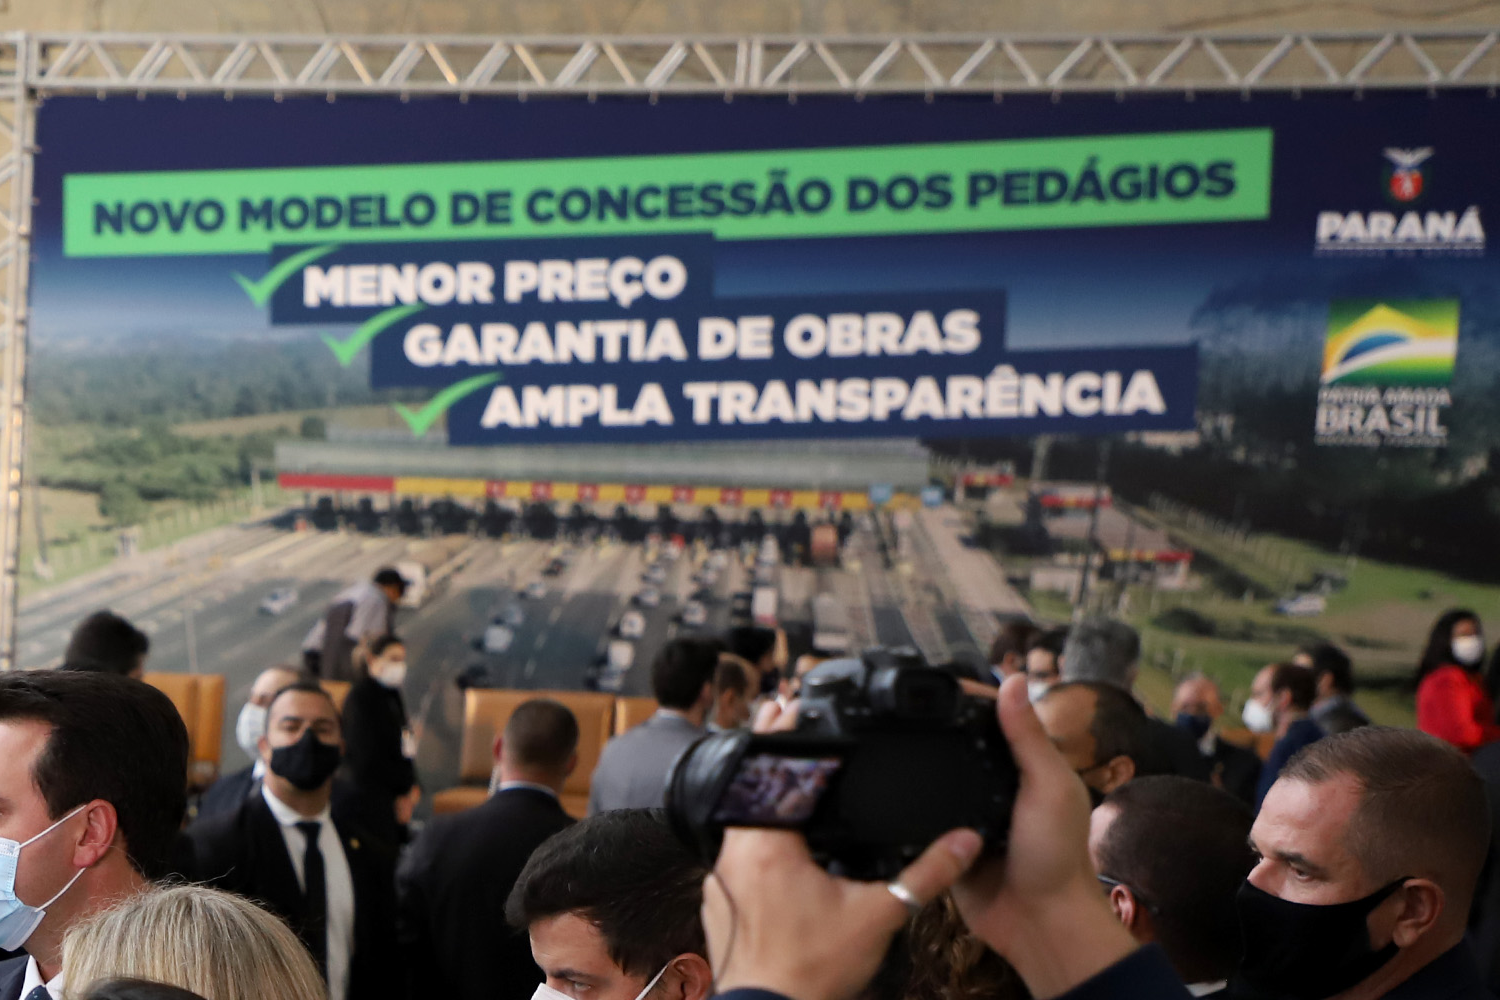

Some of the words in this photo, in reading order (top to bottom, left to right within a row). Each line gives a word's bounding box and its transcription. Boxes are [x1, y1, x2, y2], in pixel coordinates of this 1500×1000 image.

[93, 199, 225, 235] NOVO
[239, 192, 436, 232] MODELO
[450, 190, 512, 225] DE
[526, 168, 834, 224] CONCESSÃO
[846, 173, 954, 213] DOS
[966, 154, 1237, 209] PEDÁGIOS
[1315, 204, 1486, 244] PARANÁ
[303, 261, 496, 308] MENOR
[503, 255, 688, 308] PREÇO
[403, 317, 688, 368] GARANTIA
[698, 315, 775, 361] DE
[783, 309, 982, 359] OBRAS
[480, 382, 675, 429] AMPLA
[683, 363, 1167, 425] TRANSPARÊNCIA
[1315, 401, 1448, 437] BRASIL
